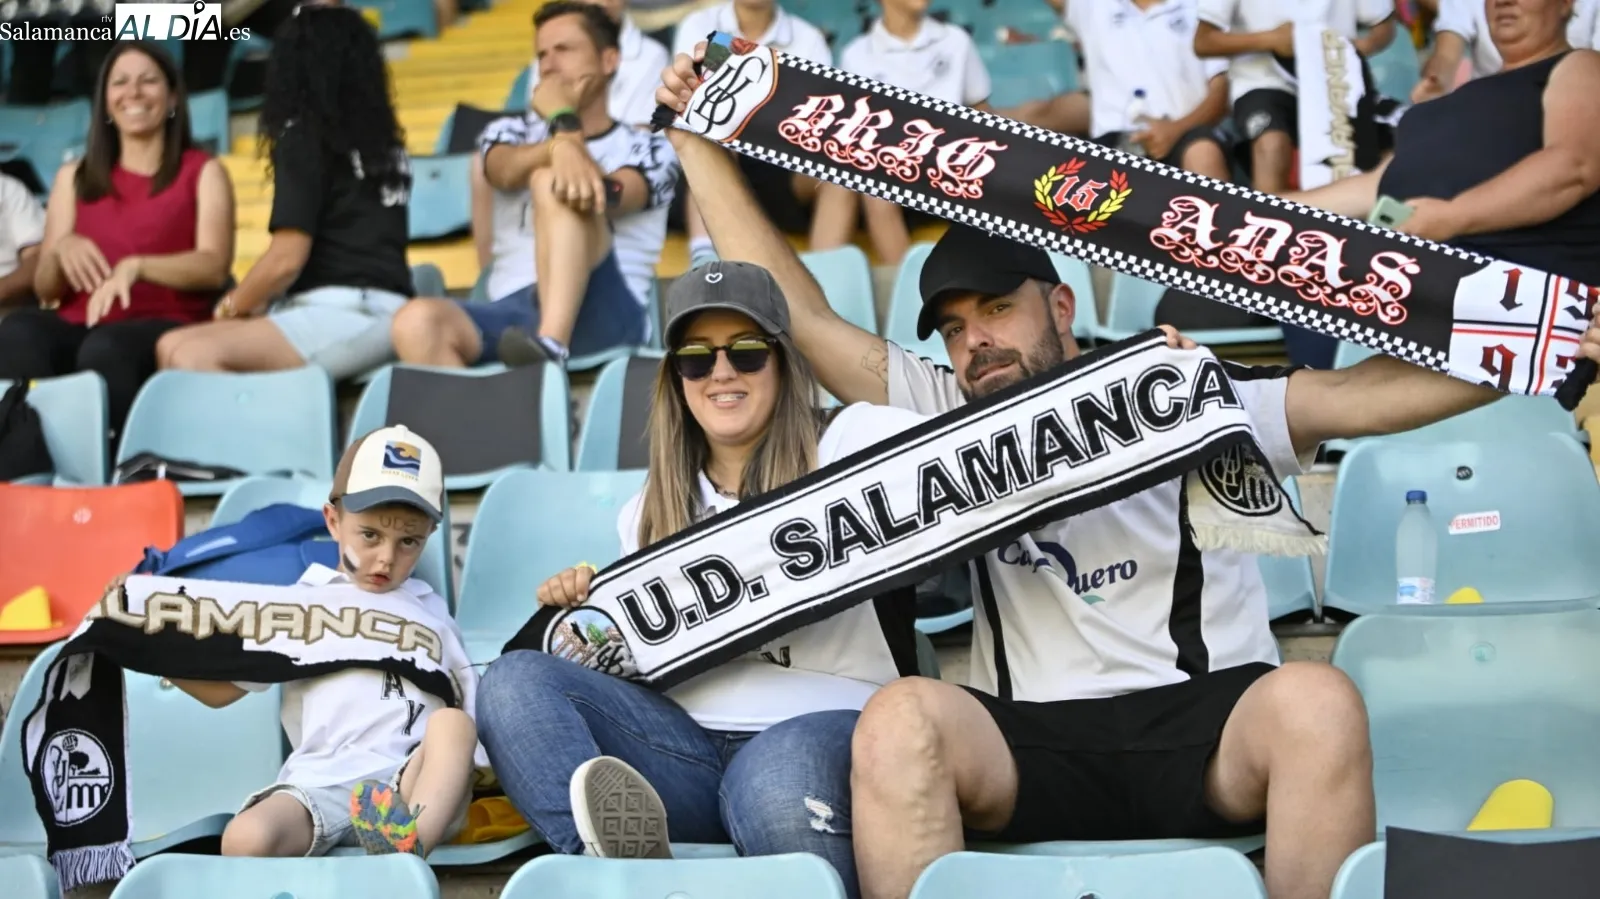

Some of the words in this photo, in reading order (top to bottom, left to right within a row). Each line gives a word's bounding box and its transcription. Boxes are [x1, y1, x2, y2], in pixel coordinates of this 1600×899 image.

[1149, 195, 1421, 326] ADAS
[617, 554, 770, 647] U.D.
[769, 357, 1246, 581] SALAMANCA
